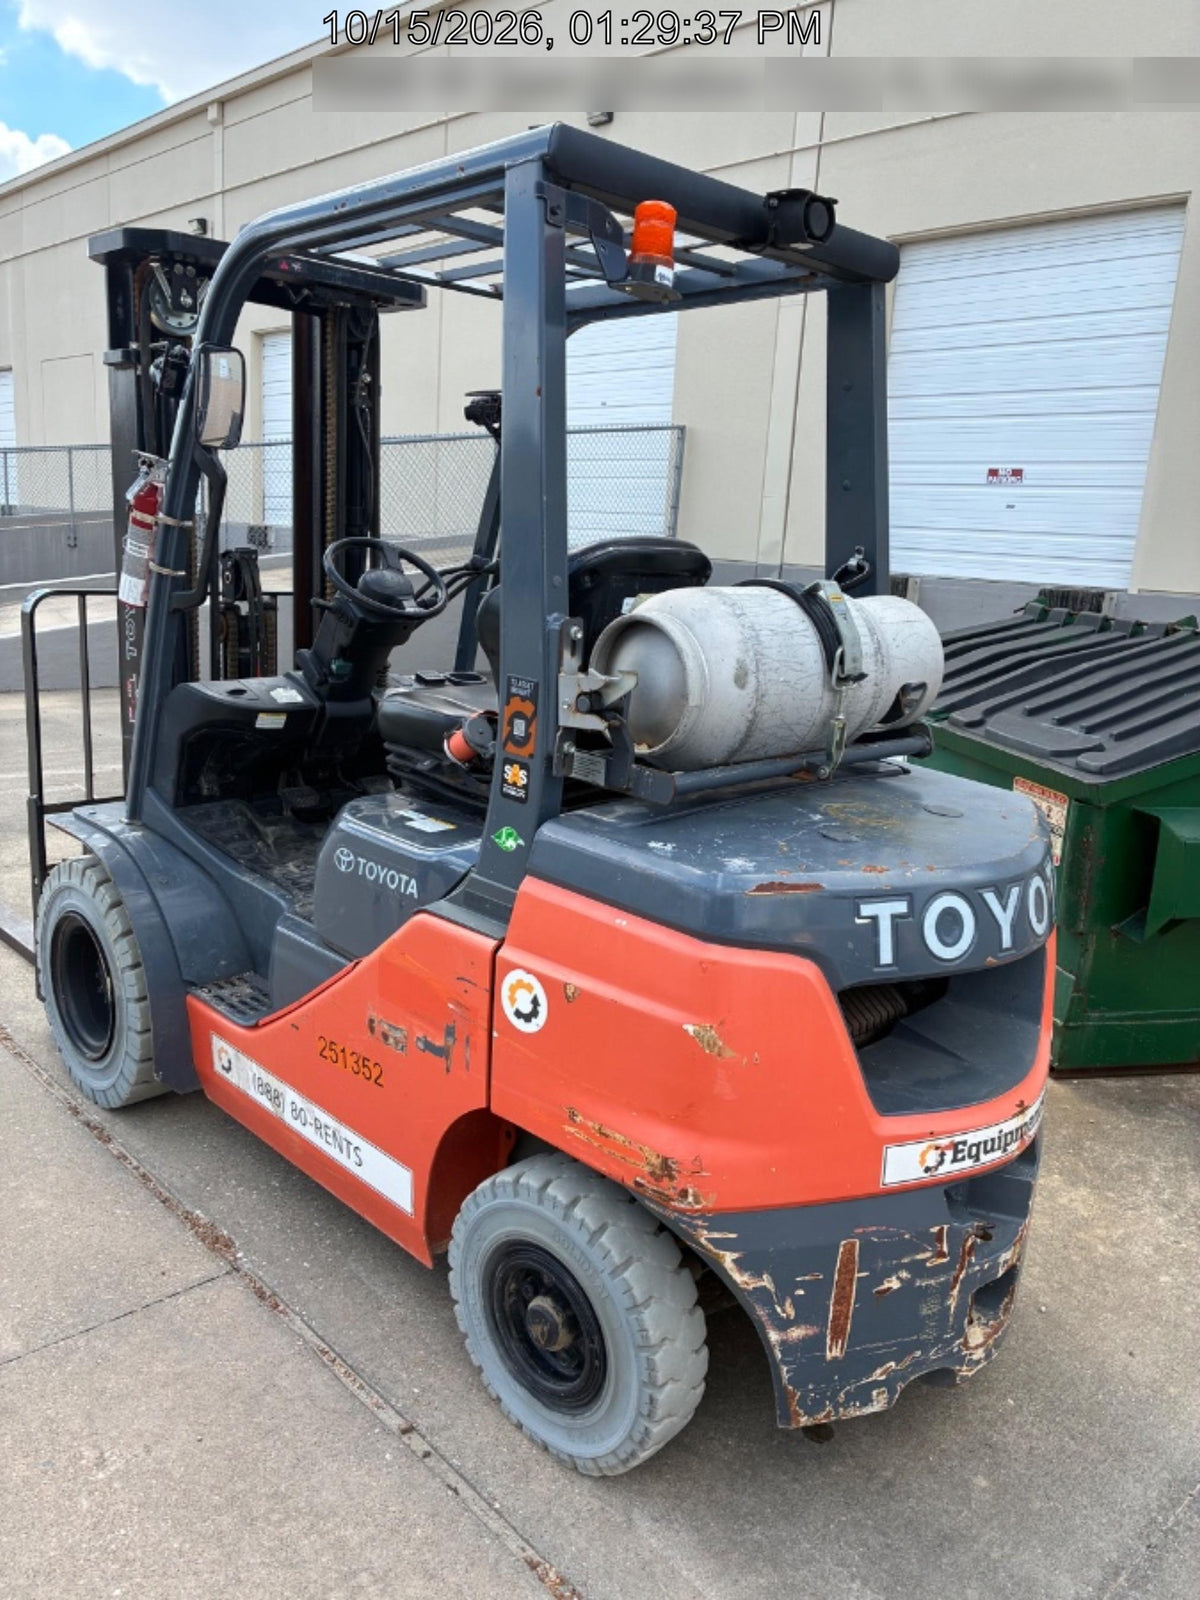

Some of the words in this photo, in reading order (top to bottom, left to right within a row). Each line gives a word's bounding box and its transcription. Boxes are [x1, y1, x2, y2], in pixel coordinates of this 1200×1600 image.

[998, 468, 1012, 476] NO
[357, 857, 419, 899] TOYOTA
[318, 1035, 385, 1088] 251352
[252, 1073, 286, 1113] (888)
[290, 1101, 364, 1168] 80-RENTS
[951, 1111, 1043, 1165] Equipm
